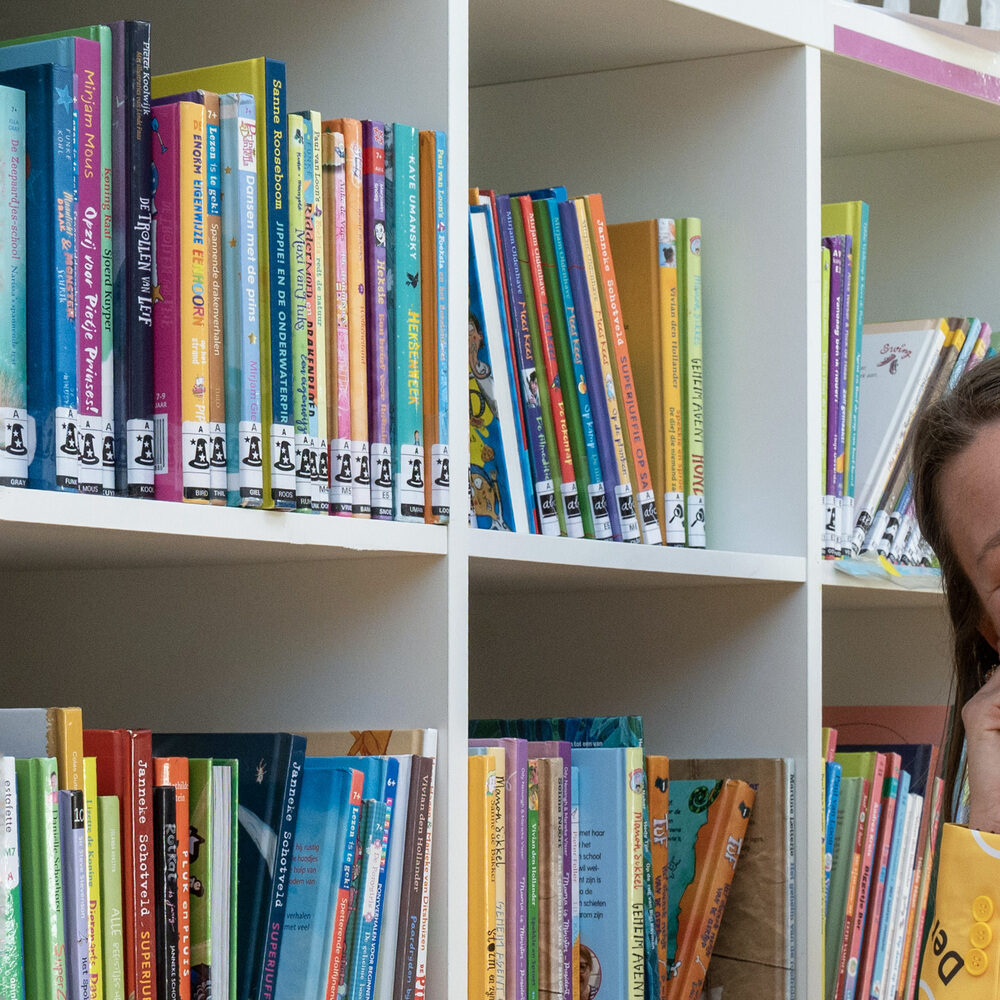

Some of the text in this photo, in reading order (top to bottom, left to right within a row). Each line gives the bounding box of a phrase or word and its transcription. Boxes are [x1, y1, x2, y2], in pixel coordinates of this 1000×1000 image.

[142, 41, 151, 116] Pieter Koolwijk
[80, 68, 99, 179] Mirjam Mous
[272, 79, 285, 211] Sanne Rooseboom
[192, 134, 202, 174] ENORM
[139, 196, 150, 211] DE
[192, 179, 204, 245] EIGENWIJZE
[245, 175, 256, 229] Dansen
[408, 155, 419, 261] KAYE UMANSKY
[102, 168, 114, 332] Koning Raaf Sjoerd Kuyper
[247, 232, 256, 261] met
[275, 220, 286, 265] JIPPIE!
[528, 212, 546, 297] Mirjam Oldenhave
[191, 249, 206, 328] EENHOORN
[210, 223, 221, 357] Spannende drakenverhalen
[248, 264, 257, 285] de
[278, 269, 286, 286] EN
[278, 290, 287, 307] DE
[376, 259, 386, 305] Heksie
[596, 219, 625, 347] Janneke Schotveld
[670, 287, 679, 316] Vivian
[80, 206, 99, 414] Opzij voor Pietje Prinses!
[137, 295, 153, 328] LEIF
[246, 287, 257, 323] prins
[249, 360, 259, 402] Mirjam
[408, 311, 421, 406] HEKSENWEEK
[619, 356, 645, 467] SUPERJUFFIE OP
[278, 490, 294, 498] ROOS
[4, 779, 12, 834] estafette
[137, 759, 151, 917] Janneke Schotveld
[274, 761, 301, 909] Janneke Schotveld
[112, 907, 123, 938] ALLE
[182, 925, 190, 977] PLUIS
